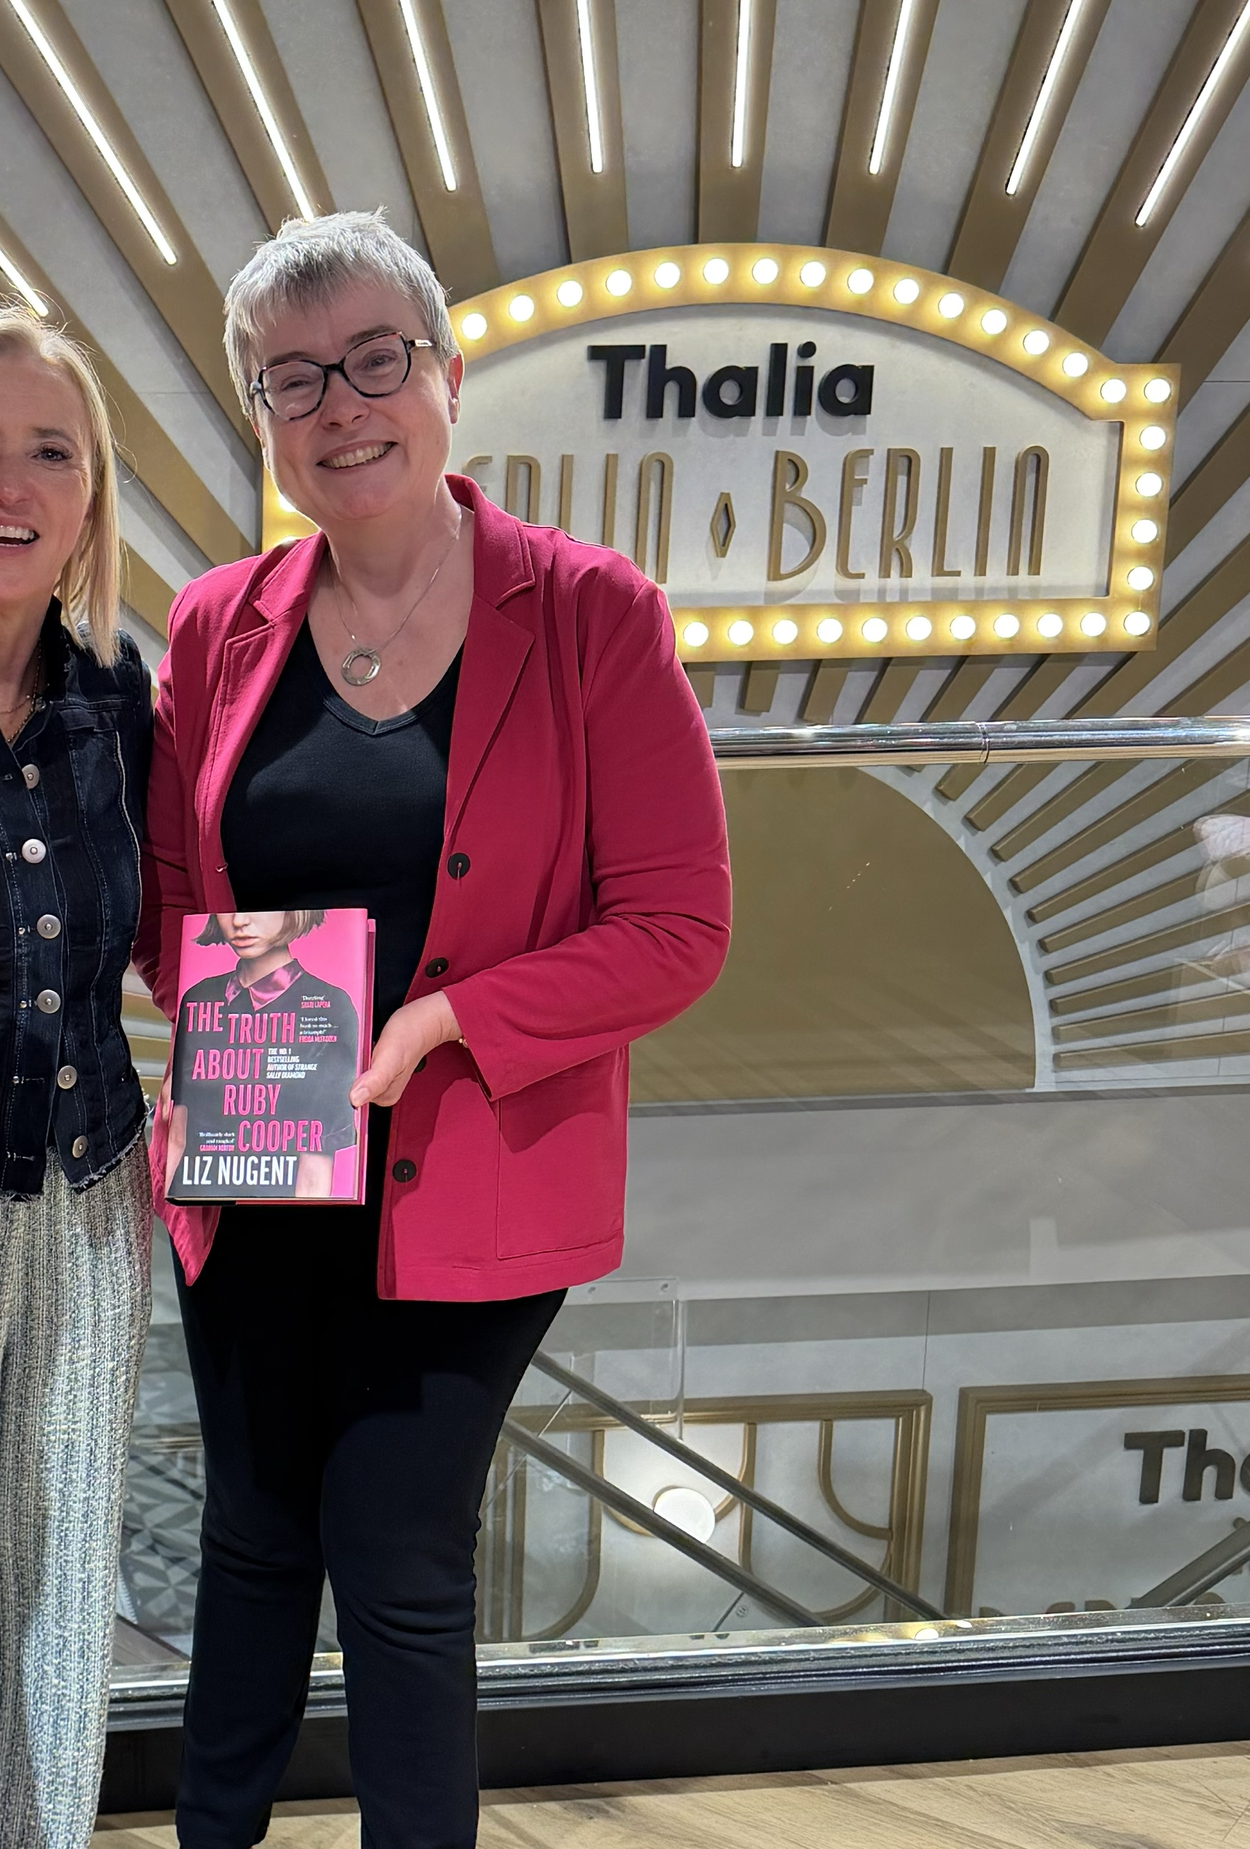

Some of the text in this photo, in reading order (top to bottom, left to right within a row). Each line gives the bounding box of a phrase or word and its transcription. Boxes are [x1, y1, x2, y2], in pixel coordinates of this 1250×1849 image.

[587, 341, 875, 419] Thalia
[767, 445, 1050, 582] BERLIN
[186, 1001, 225, 1032] THE
[228, 1012, 296, 1045] TRUTH
[191, 1049, 264, 1080] ABOUT
[223, 1084, 281, 1116] RUBY
[238, 1120, 323, 1152] COOPER
[182, 1156, 297, 1186] LIZ NUGENT
[1124, 1429, 1250, 1504] Th
